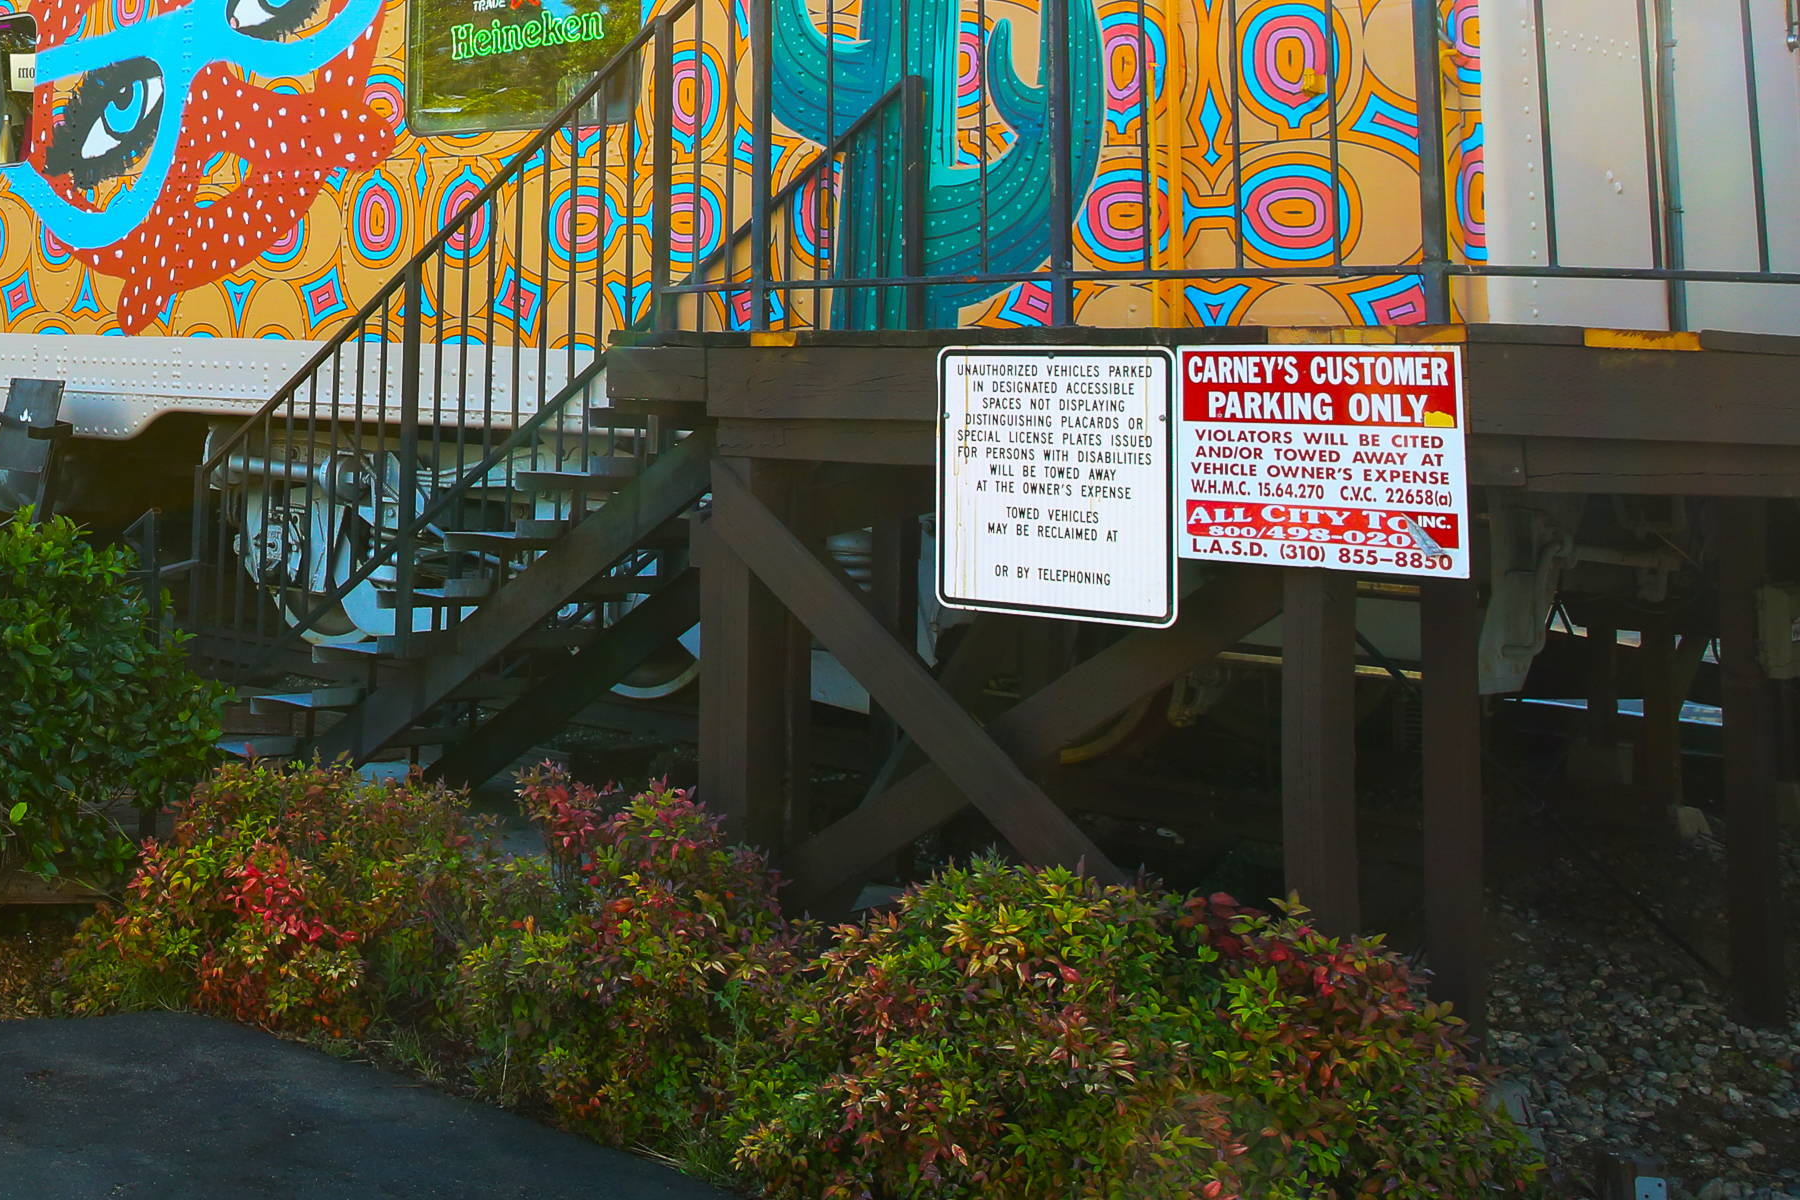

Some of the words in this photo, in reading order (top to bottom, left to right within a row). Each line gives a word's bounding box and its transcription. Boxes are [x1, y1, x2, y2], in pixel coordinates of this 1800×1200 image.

[450, 10, 605, 61] Heineken
[957, 364, 1038, 377] UNAUTHORIZED
[1046, 365, 1100, 378] VEHICLES
[1108, 365, 1153, 378] PARKED
[1187, 355, 1299, 385] CARNEY'S
[1310, 356, 1449, 386] CUSTOMER
[973, 381, 984, 393] IN
[992, 381, 1058, 394] DESIGNATED
[1066, 382, 1135, 395] ACCESSIBLE
[982, 397, 1022, 410] SPACES
[1030, 398, 1050, 411] NOT
[1059, 399, 1125, 412] DISPLAYING
[1208, 391, 1333, 421] PARKING
[1348, 393, 1429, 423] ONLY
[965, 413, 1052, 428] DISTINGUISHING
[1061, 416, 1120, 429] PLACARDS
[1128, 417, 1143, 430] OR
[957, 430, 1001, 443] SPECIAL
[1009, 431, 1054, 445] LICENSE
[1062, 433, 1102, 446] PLATES
[1111, 434, 1153, 447] ISSUED
[1194, 428, 1293, 444] VIOLATORS
[1303, 431, 1348, 446] WILL
[1359, 433, 1380, 447] BE
[1391, 434, 1444, 449] CITED
[958, 446, 978, 459] FOR
[986, 447, 1035, 461] PERSONS
[1043, 449, 1069, 462] WITH
[1078, 450, 1152, 466] DISABILITIES
[1195, 445, 1264, 460] AND/OR
[1273, 448, 1341, 463] TOWED
[1352, 451, 1409, 466] AWAY
[1420, 454, 1444, 467] AT
[989, 464, 1014, 477] WILL
[1022, 465, 1036, 478] BE
[1044, 466, 1079, 480] TOWED
[1088, 468, 1116, 481] AWAY
[1190, 462, 1257, 477] VEHICLE
[1266, 465, 1353, 481] OWNER'S
[1363, 469, 1450, 485] EXPENSE
[976, 480, 988, 492] AT
[995, 480, 1015, 494] THE
[1023, 482, 1072, 496] OWNER'S
[1081, 485, 1132, 499] EXPENSE
[1190, 479, 1251, 496] W.H.M.C.
[1257, 481, 1324, 500] 15.64.270
[1339, 486, 1377, 502] C.V.C.
[1385, 487, 1453, 507] 22658(a)
[1006, 506, 1040, 520] TOWED
[1048, 509, 1099, 523] VEHICLES
[1187, 505, 1253, 525] ALL
[1261, 504, 1352, 526] CITY
[1417, 515, 1452, 529] INC.
[988, 522, 1008, 535] MAY
[1016, 524, 1030, 537] BE
[1037, 525, 1098, 541] RECLAIMED
[1106, 530, 1118, 543] AT
[1208, 525, 1421, 548] 800/498-020
[1191, 538, 1268, 558] L.A.S.D.
[1280, 543, 1326, 563] (310)
[995, 565, 1009, 577] OR
[1017, 566, 1030, 579] BY
[1038, 568, 1111, 586] TELEPHONING
